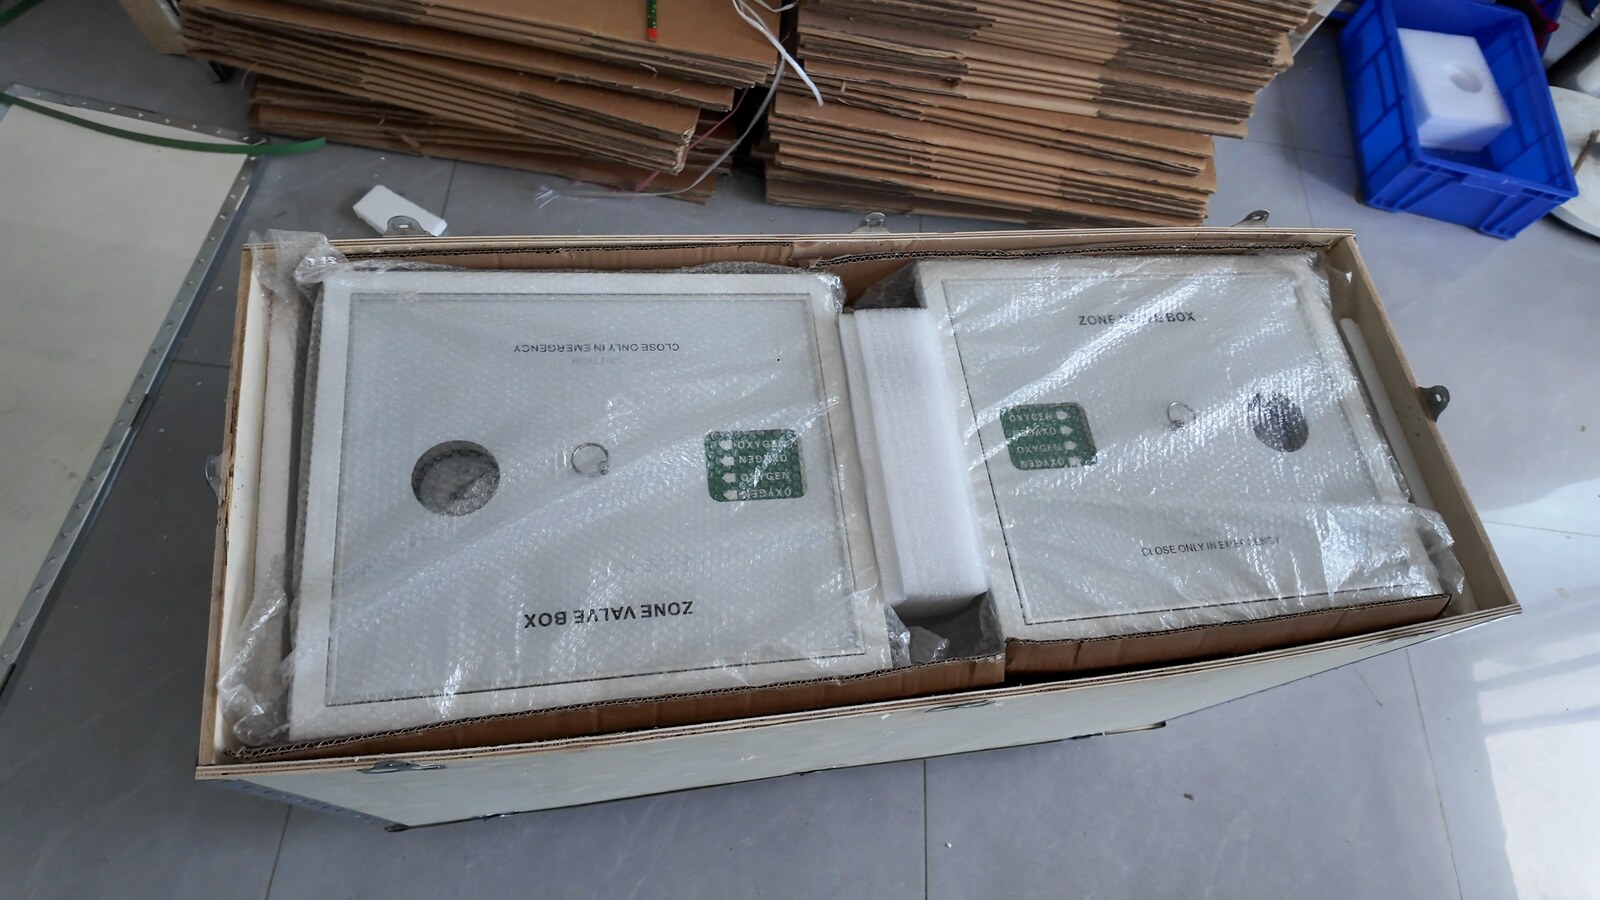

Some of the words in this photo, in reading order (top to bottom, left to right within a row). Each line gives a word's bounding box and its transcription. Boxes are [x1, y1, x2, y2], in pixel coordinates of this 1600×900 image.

[1077, 314, 1116, 326] ZONE
[1165, 311, 1196, 323] BOX
[513, 344, 591, 353] EMERGENCY
[593, 344, 605, 352] IN
[608, 343, 639, 352] ONLY
[642, 343, 680, 352] CLOSE
[737, 440, 787, 450] OXYGE
[739, 454, 788, 464] OXGEN
[1141, 544, 1177, 556] CLOSE
[1178, 543, 1204, 553] ONLY
[1206, 541, 1217, 550] IN
[574, 606, 636, 624] VALVE
[641, 601, 693, 619] ZONE
[524, 611, 567, 628] BOX
